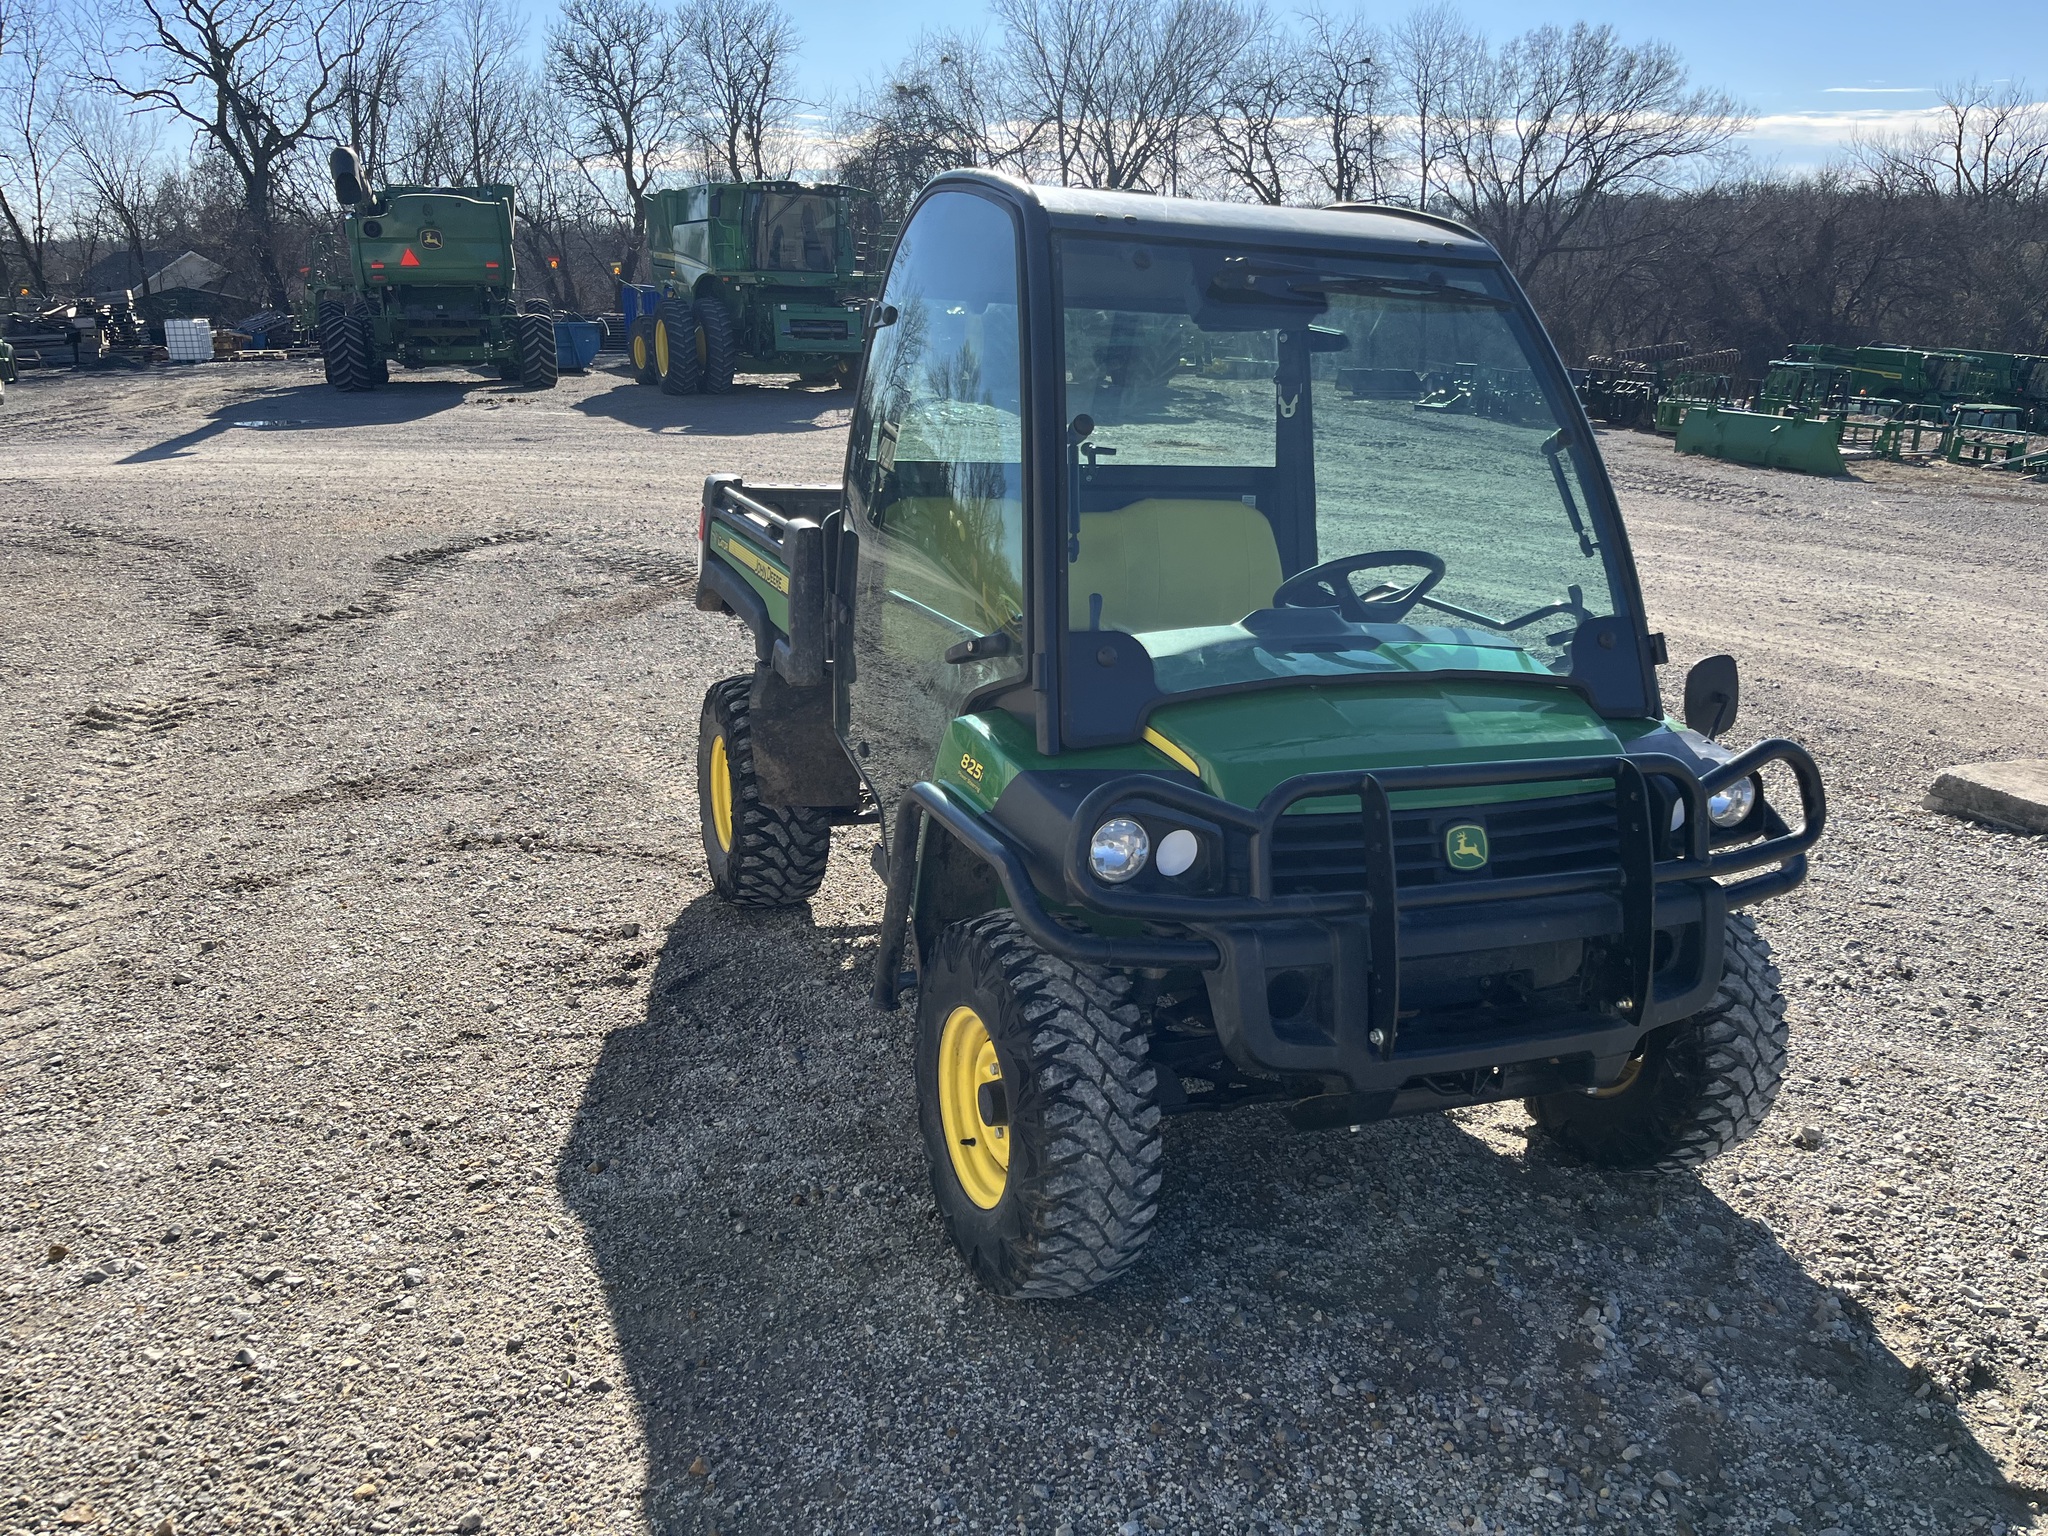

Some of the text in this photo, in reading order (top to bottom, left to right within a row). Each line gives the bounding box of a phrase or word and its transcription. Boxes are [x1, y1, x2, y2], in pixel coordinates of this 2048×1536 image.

[755, 558, 782, 592] JOHN DEERE
[960, 753, 983, 782] 825i
